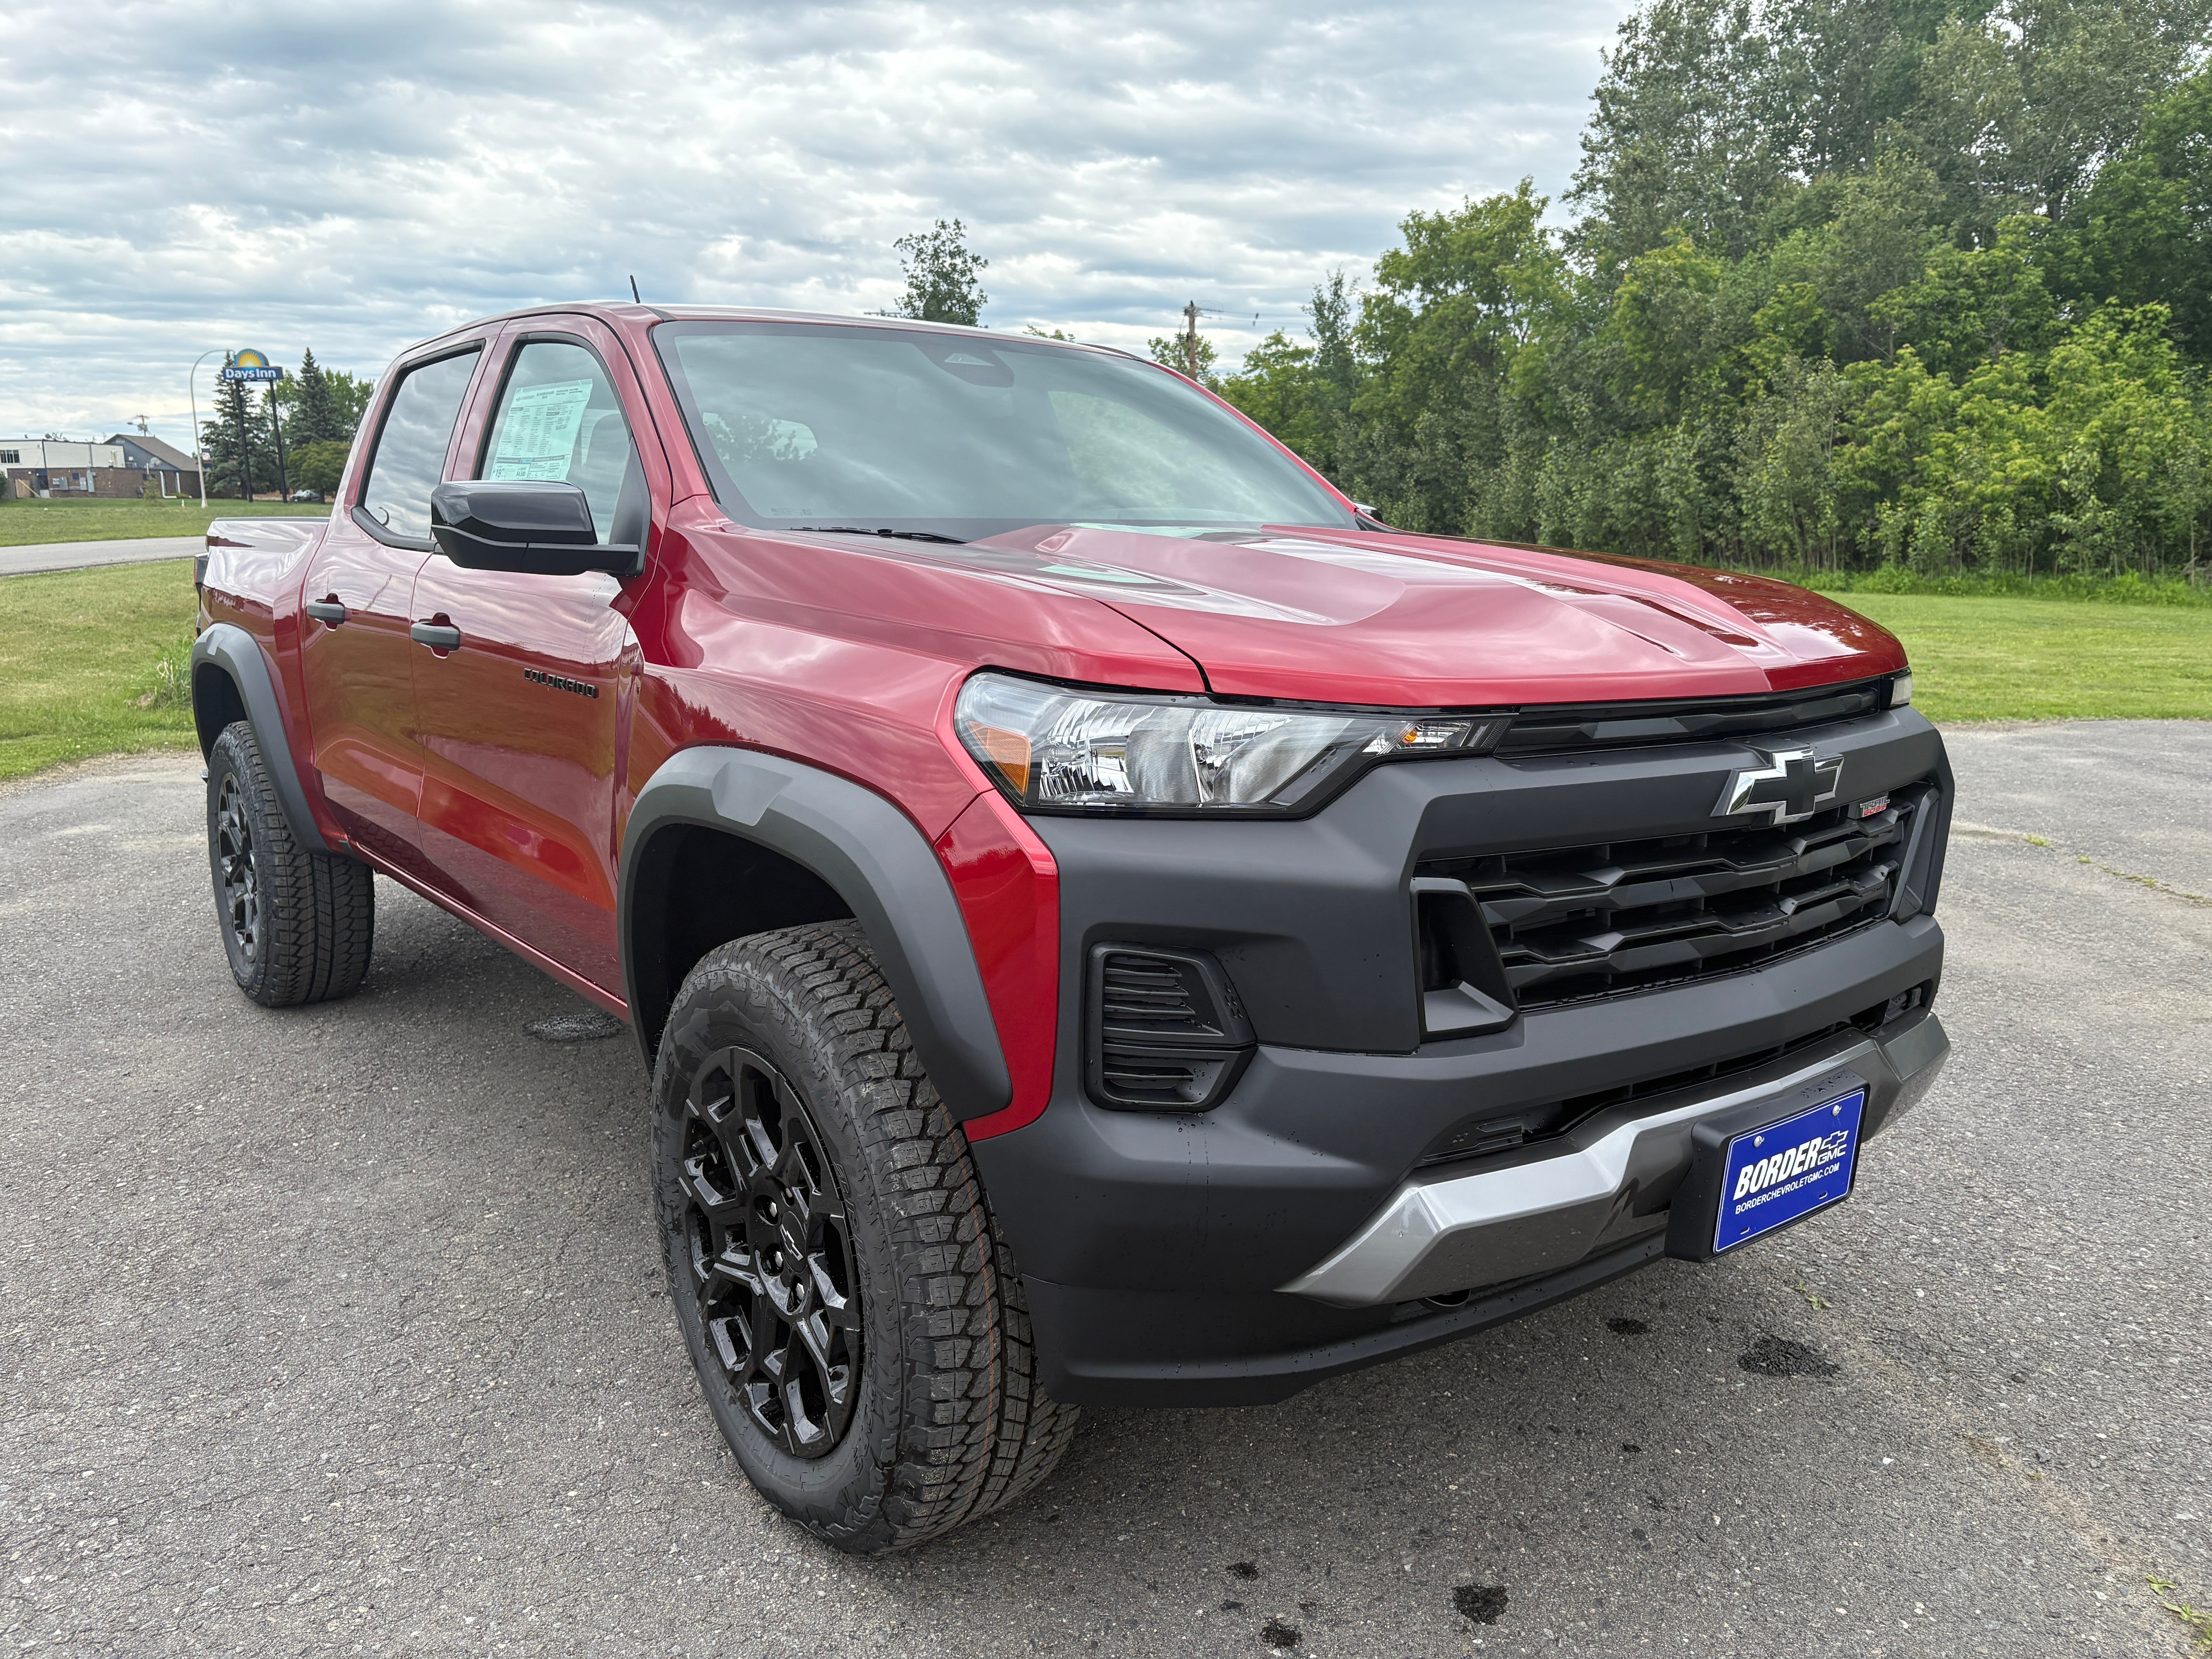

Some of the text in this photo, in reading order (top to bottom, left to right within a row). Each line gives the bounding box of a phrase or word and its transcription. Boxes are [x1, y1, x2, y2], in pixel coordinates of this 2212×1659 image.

[225, 369, 276, 379] Days Inn
[524, 668, 597, 699] COLORADO
[1860, 795, 1890, 810] TRAIL
[1863, 804, 1887, 816] BOSS
[1817, 1144, 1847, 1166] GMC
[1733, 1136, 1822, 1201] BORDER
[1735, 1162, 1839, 1215] BORDERCHEVROLETGMC.COM
